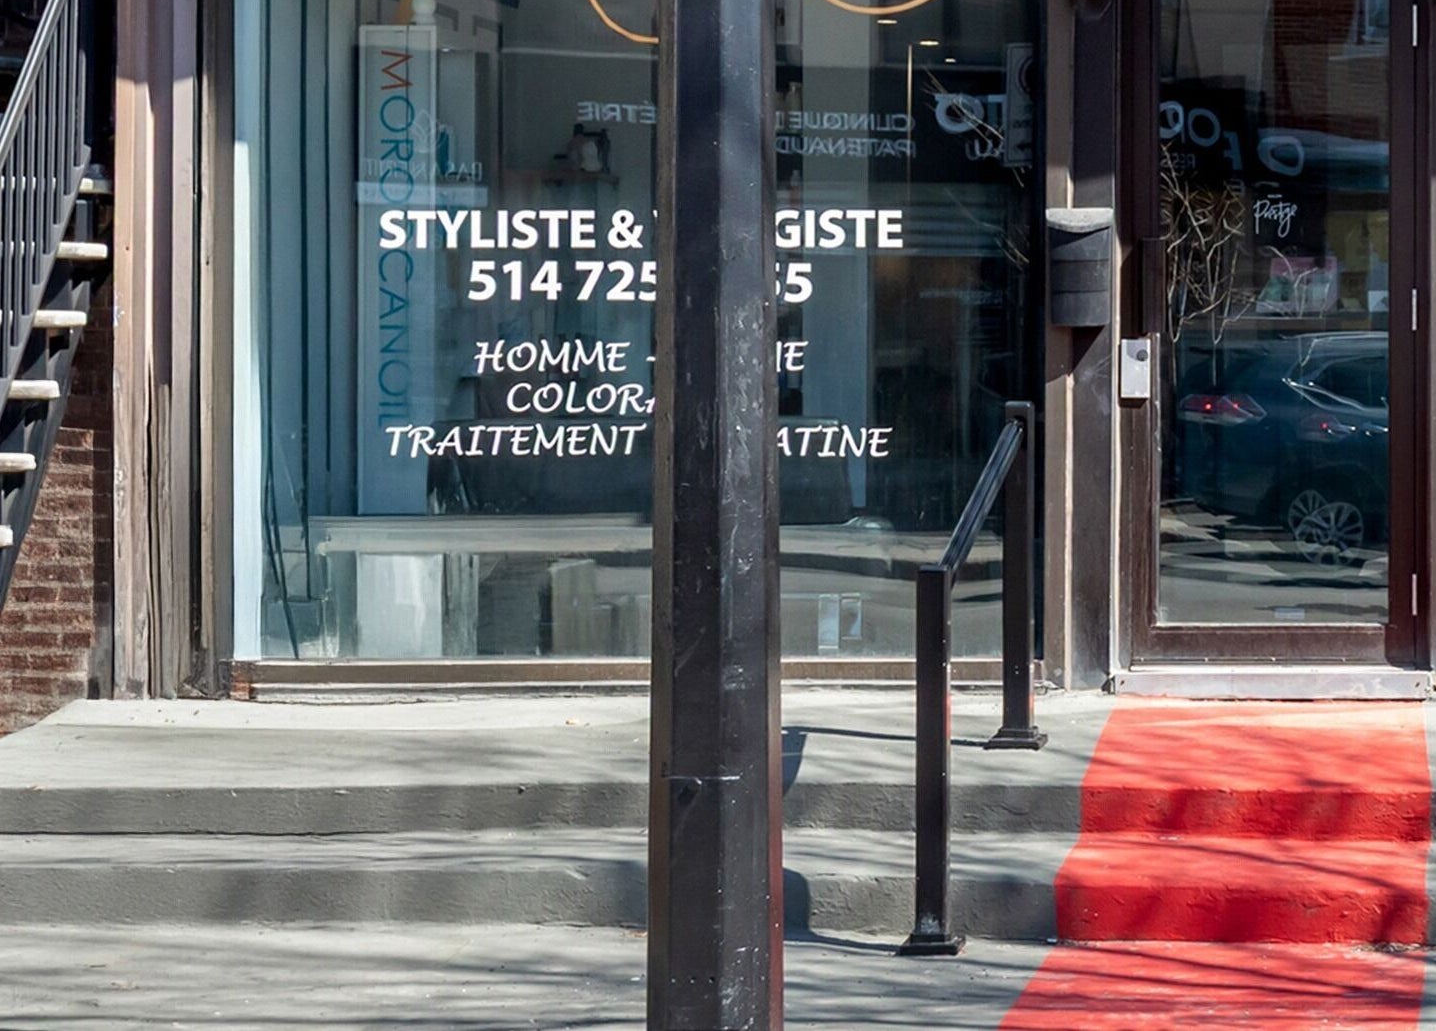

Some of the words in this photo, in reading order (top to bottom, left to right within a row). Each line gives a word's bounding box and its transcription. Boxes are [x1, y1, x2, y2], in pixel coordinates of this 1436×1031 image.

[378, 209, 596, 249] STYLISTE
[607, 209, 644, 249] &
[378, 49, 416, 427] MOROCANOIL
[467, 259, 563, 301] 514
[474, 339, 631, 374] HOMME
[384, 422, 648, 458] TRAITEMENT
[776, 426, 893, 458] ATINE
